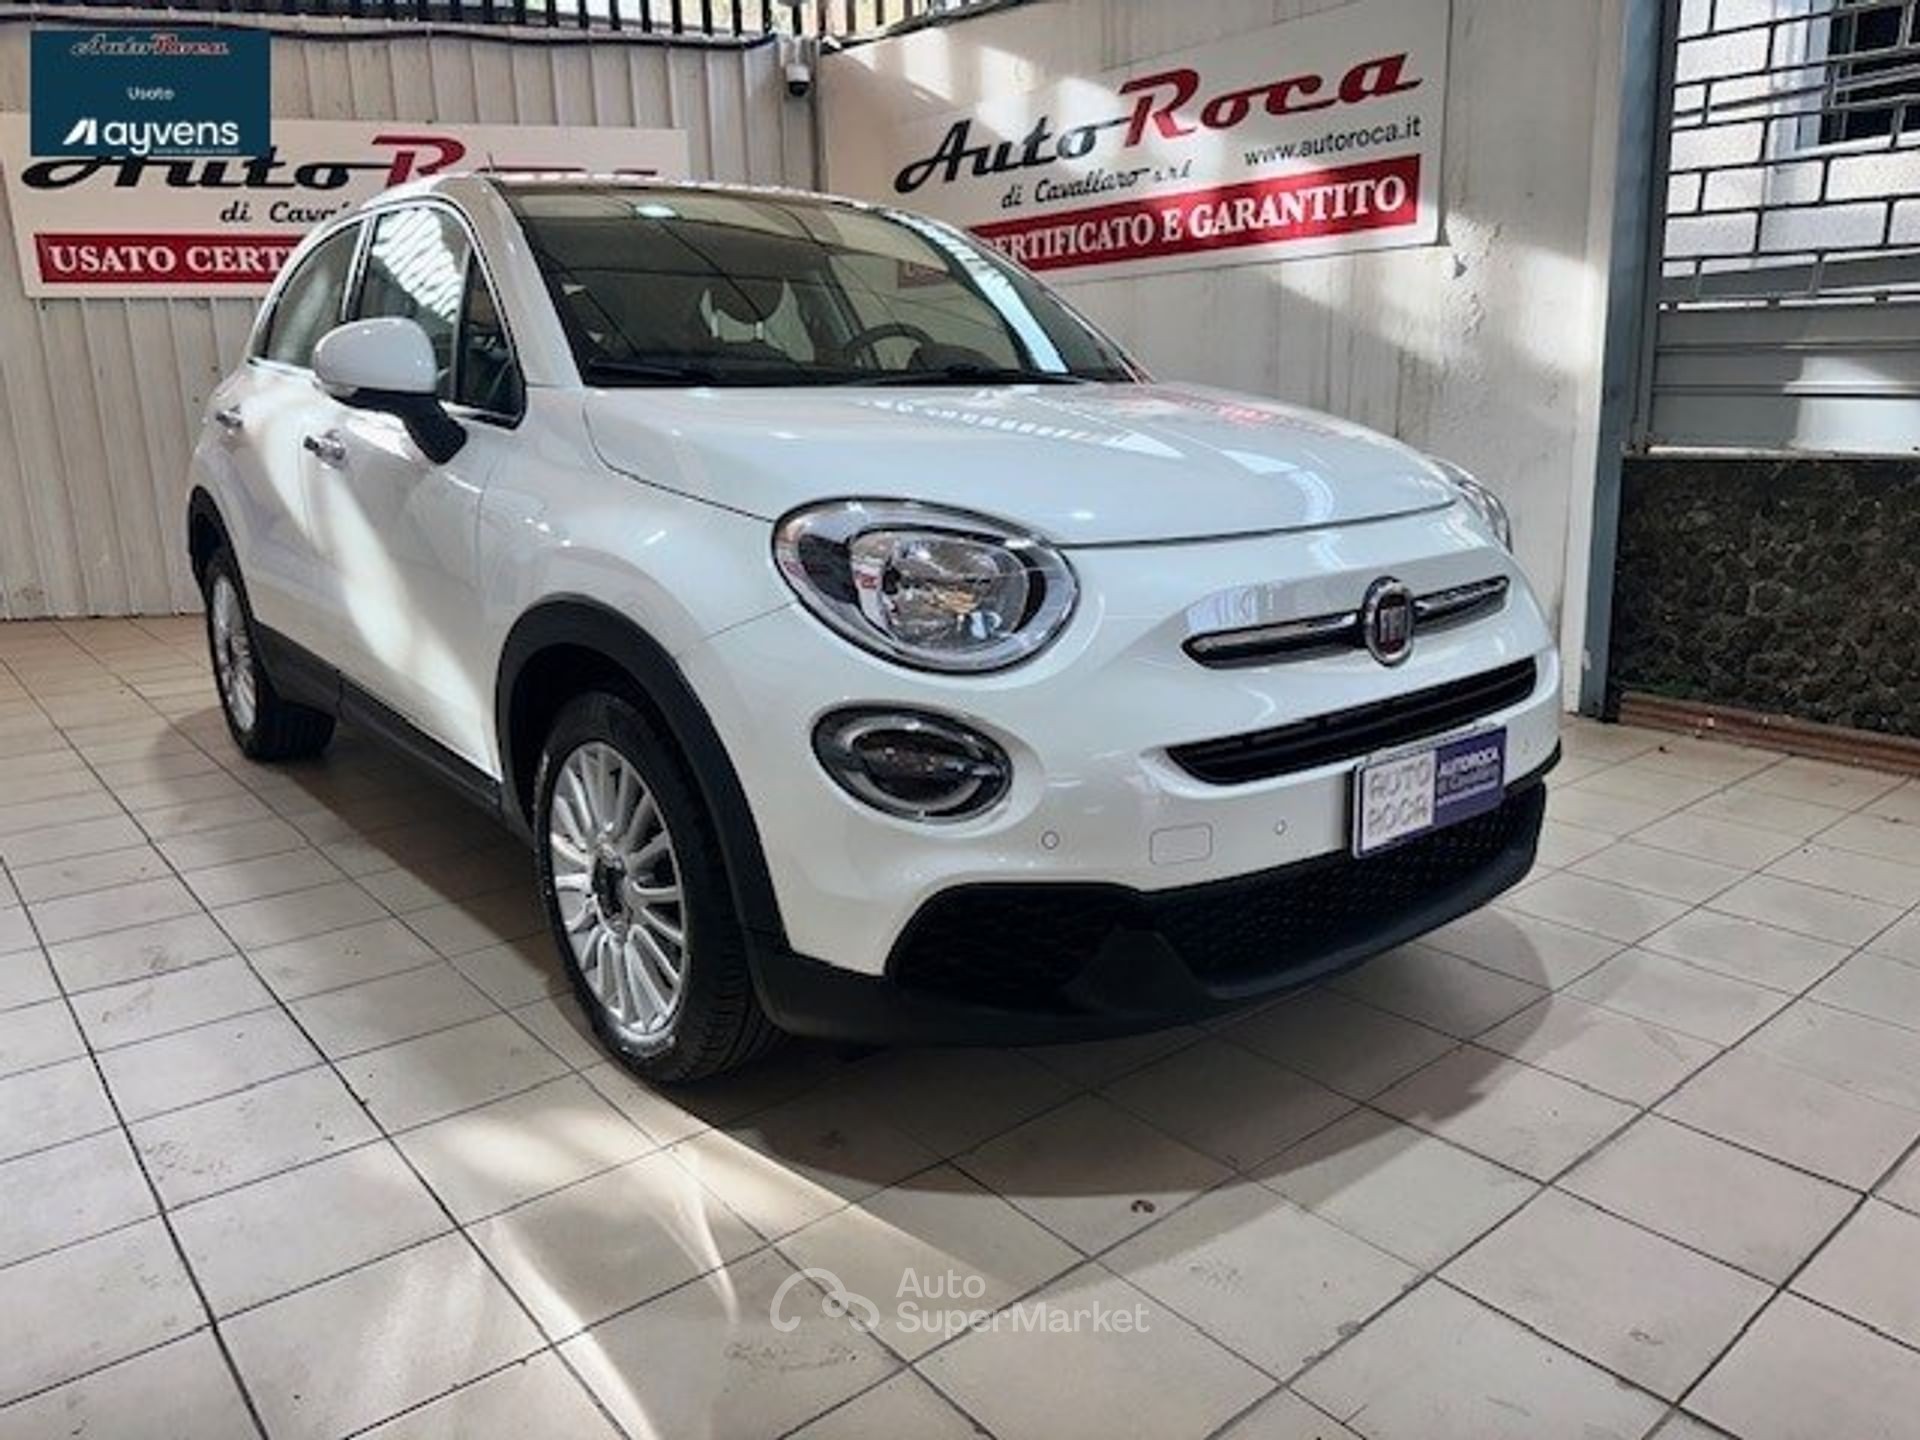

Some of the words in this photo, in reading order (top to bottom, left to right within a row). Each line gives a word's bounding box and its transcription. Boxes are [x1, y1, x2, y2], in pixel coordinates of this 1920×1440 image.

[1245, 114, 1422, 167] www.autoroca.it
[1001, 184, 1023, 209] di
[1035, 165, 1150, 204] Cavallaro
[1161, 207, 1183, 242] E
[1189, 175, 1407, 238] GARANTITO
[220, 201, 251, 223] di
[50, 244, 177, 274] USATO
[185, 244, 287, 275] CERT
